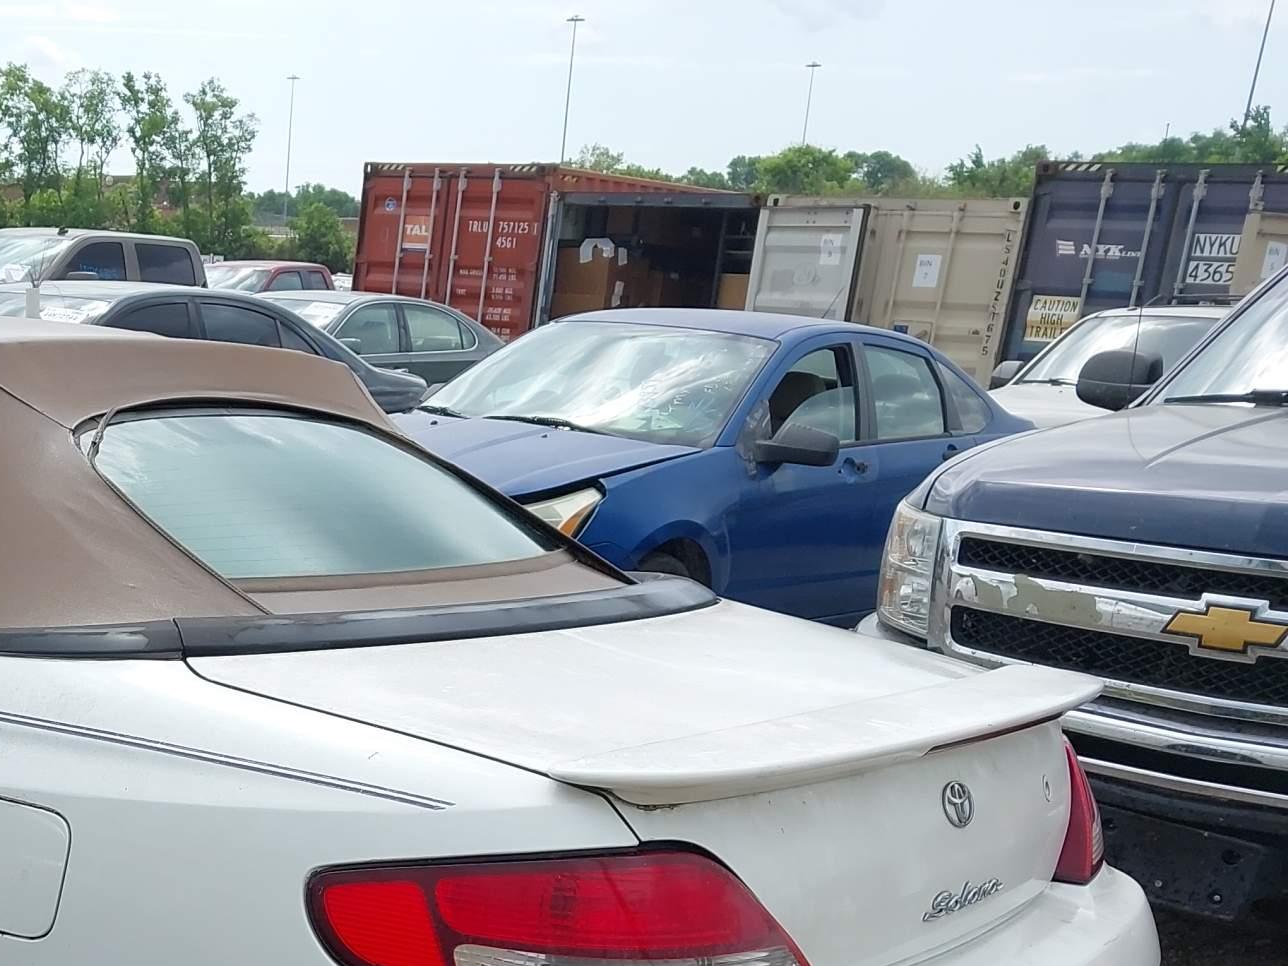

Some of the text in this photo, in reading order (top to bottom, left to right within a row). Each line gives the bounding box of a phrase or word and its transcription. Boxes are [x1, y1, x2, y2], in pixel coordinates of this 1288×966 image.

[404, 224, 429, 236] TAL
[468, 220, 489, 233] TRLU
[497, 221, 529, 234] 757125
[495, 237, 517, 249] 45G1
[1193, 235, 1242, 256] NYKU
[1188, 262, 1236, 283] 4365
[1033, 298, 1079, 313] CAUTION
[1039, 312, 1064, 326] HIGH
[921, 878, 1004, 922] Solara
